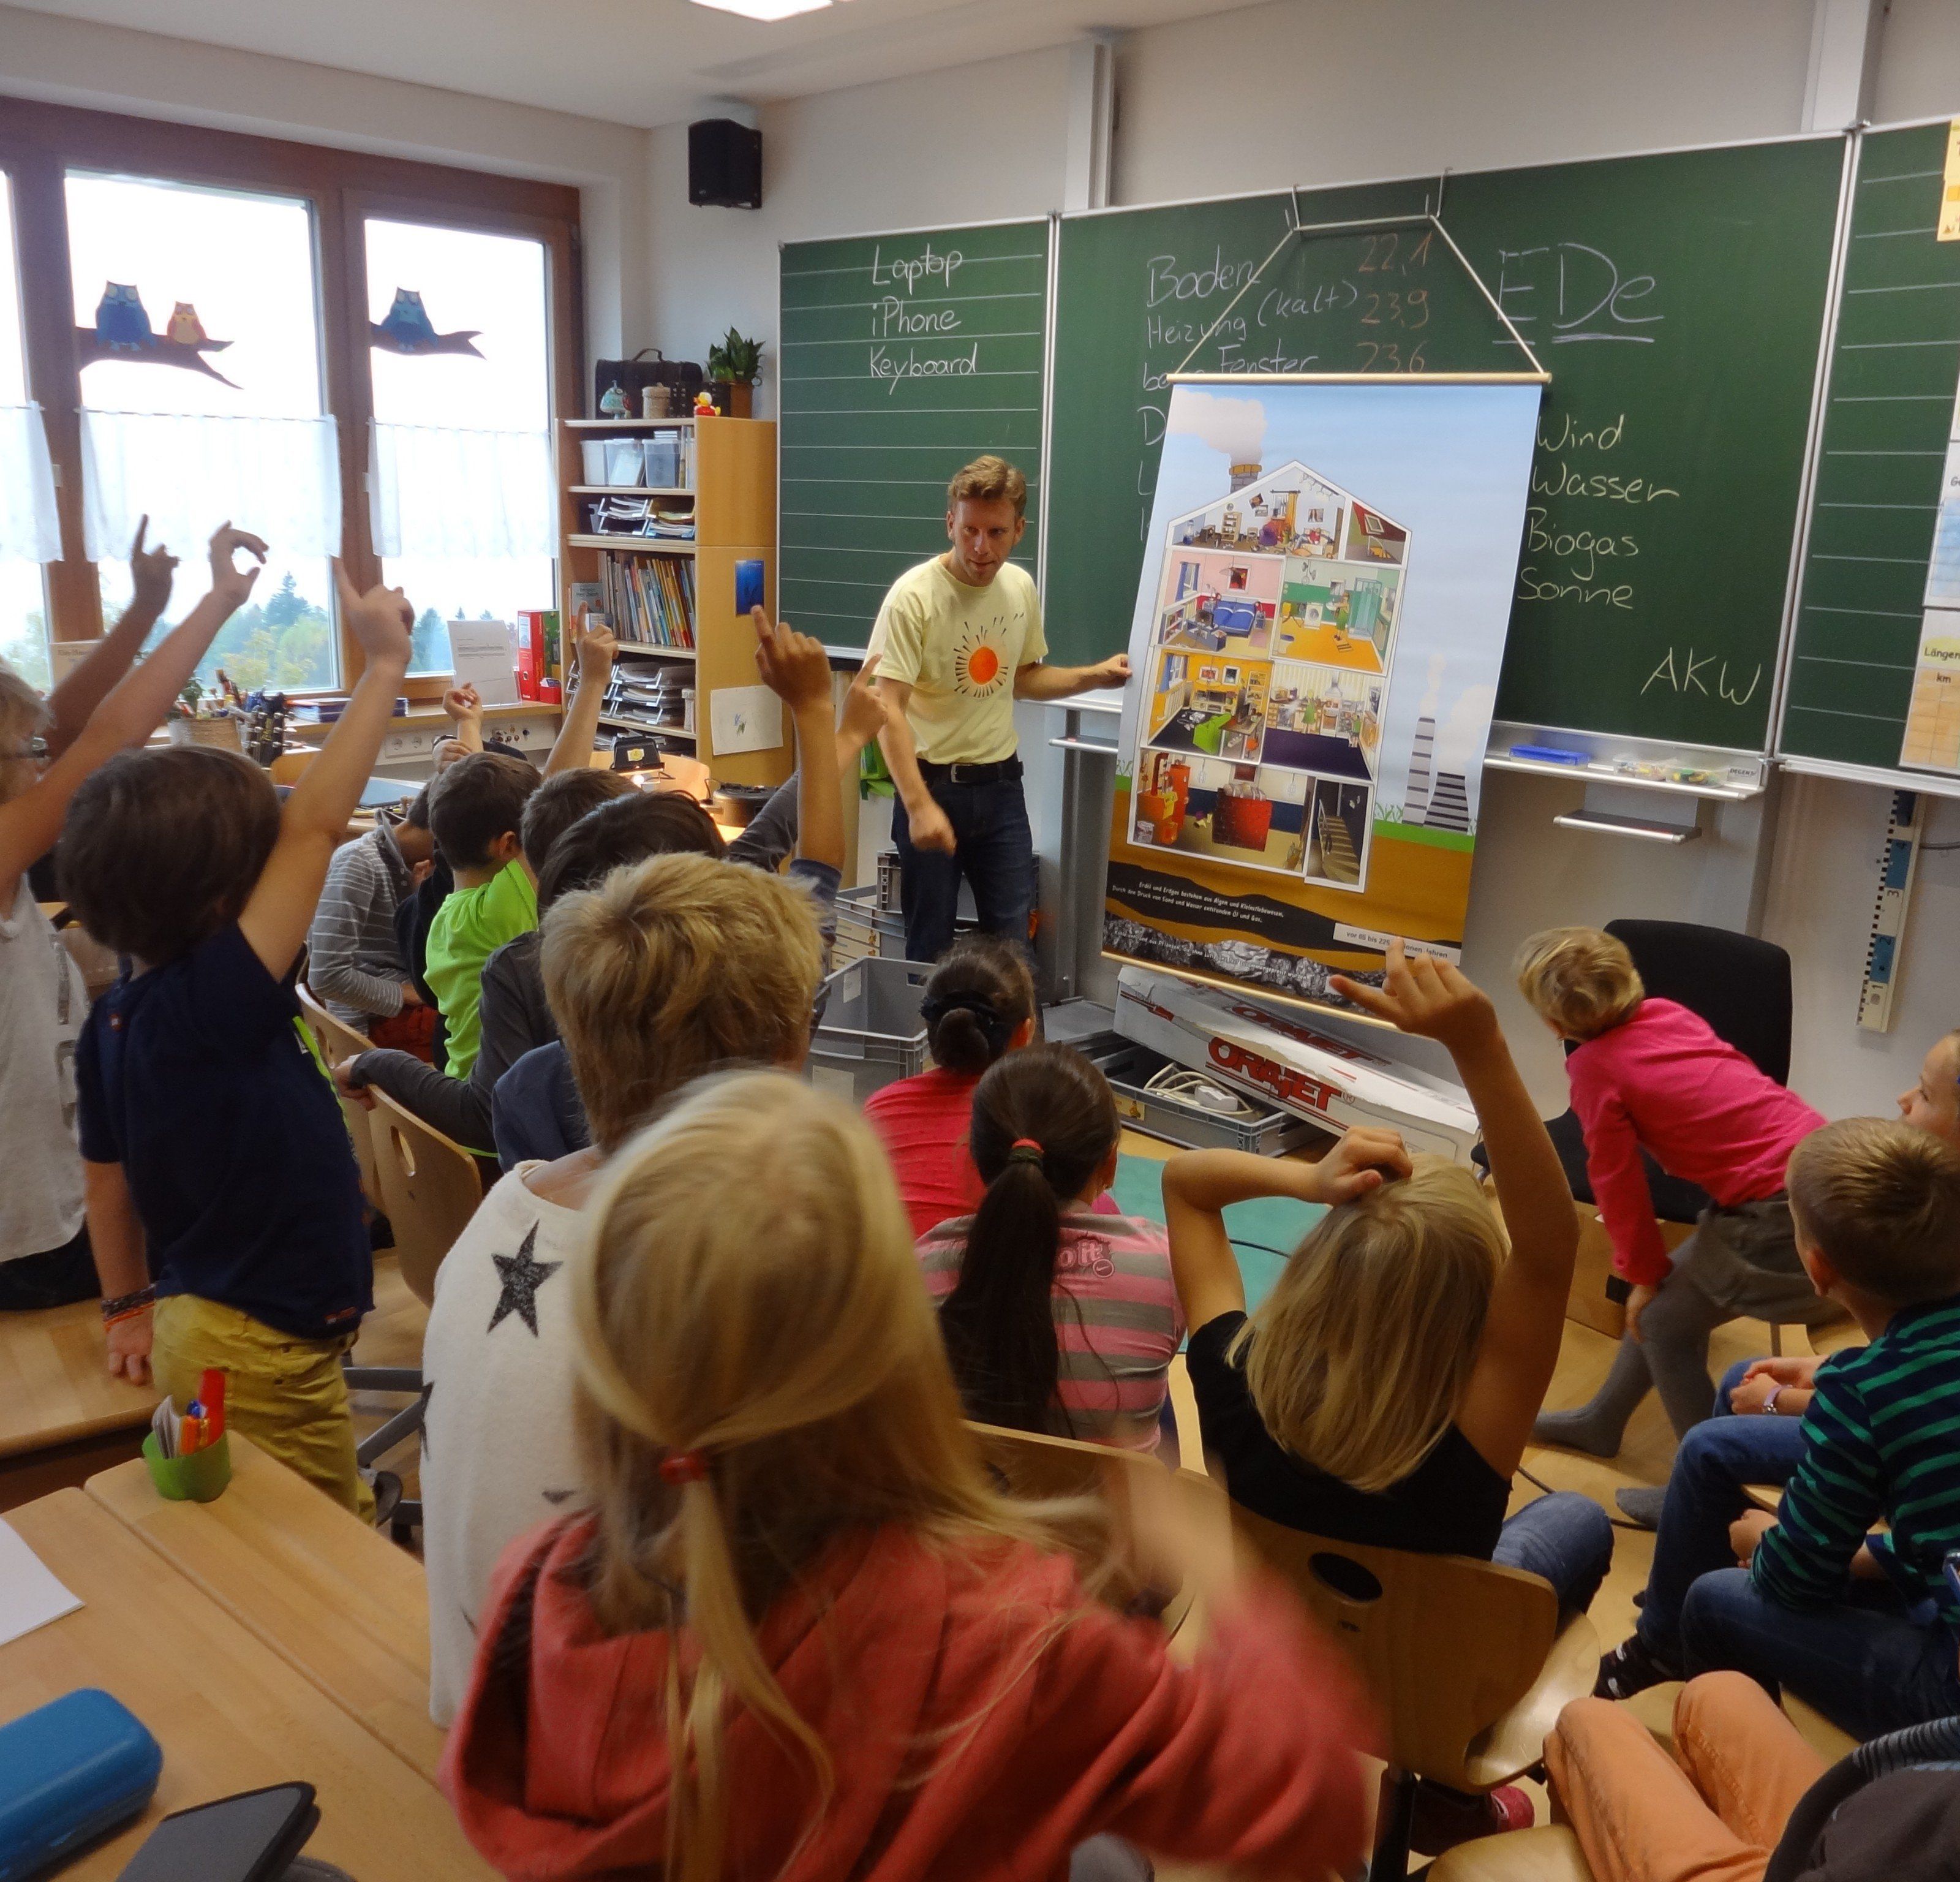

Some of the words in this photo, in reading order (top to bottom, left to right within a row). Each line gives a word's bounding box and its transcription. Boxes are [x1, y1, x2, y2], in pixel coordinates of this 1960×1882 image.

[872, 243, 963, 295] Laptop
[1146, 244, 1261, 308] Boden
[872, 295, 962, 338] iPhone
[1147, 315, 1246, 349] Heizung
[1257, 279, 1359, 327] (kalt)
[869, 342, 978, 396] Keyboard
[1218, 338, 1319, 374] Fenster
[1537, 413, 1625, 452] Wind
[1532, 461, 1679, 504] Wasser
[1527, 507, 1639, 581] Biogas
[1517, 567, 1634, 610] Sonne
[1640, 646, 1761, 706] AKW
[1936, 672, 1951, 684] km
[1112, 885, 1126, 893] Durch
[1137, 890, 1151, 899] Druck
[1162, 896, 1175, 904] Sand
[1163, 887, 1180, 896] Erdgas
[1181, 891, 1202, 900] bestehen
[1213, 897, 1228, 906] Algen
[1208, 1036, 1343, 1112] ORAJET
